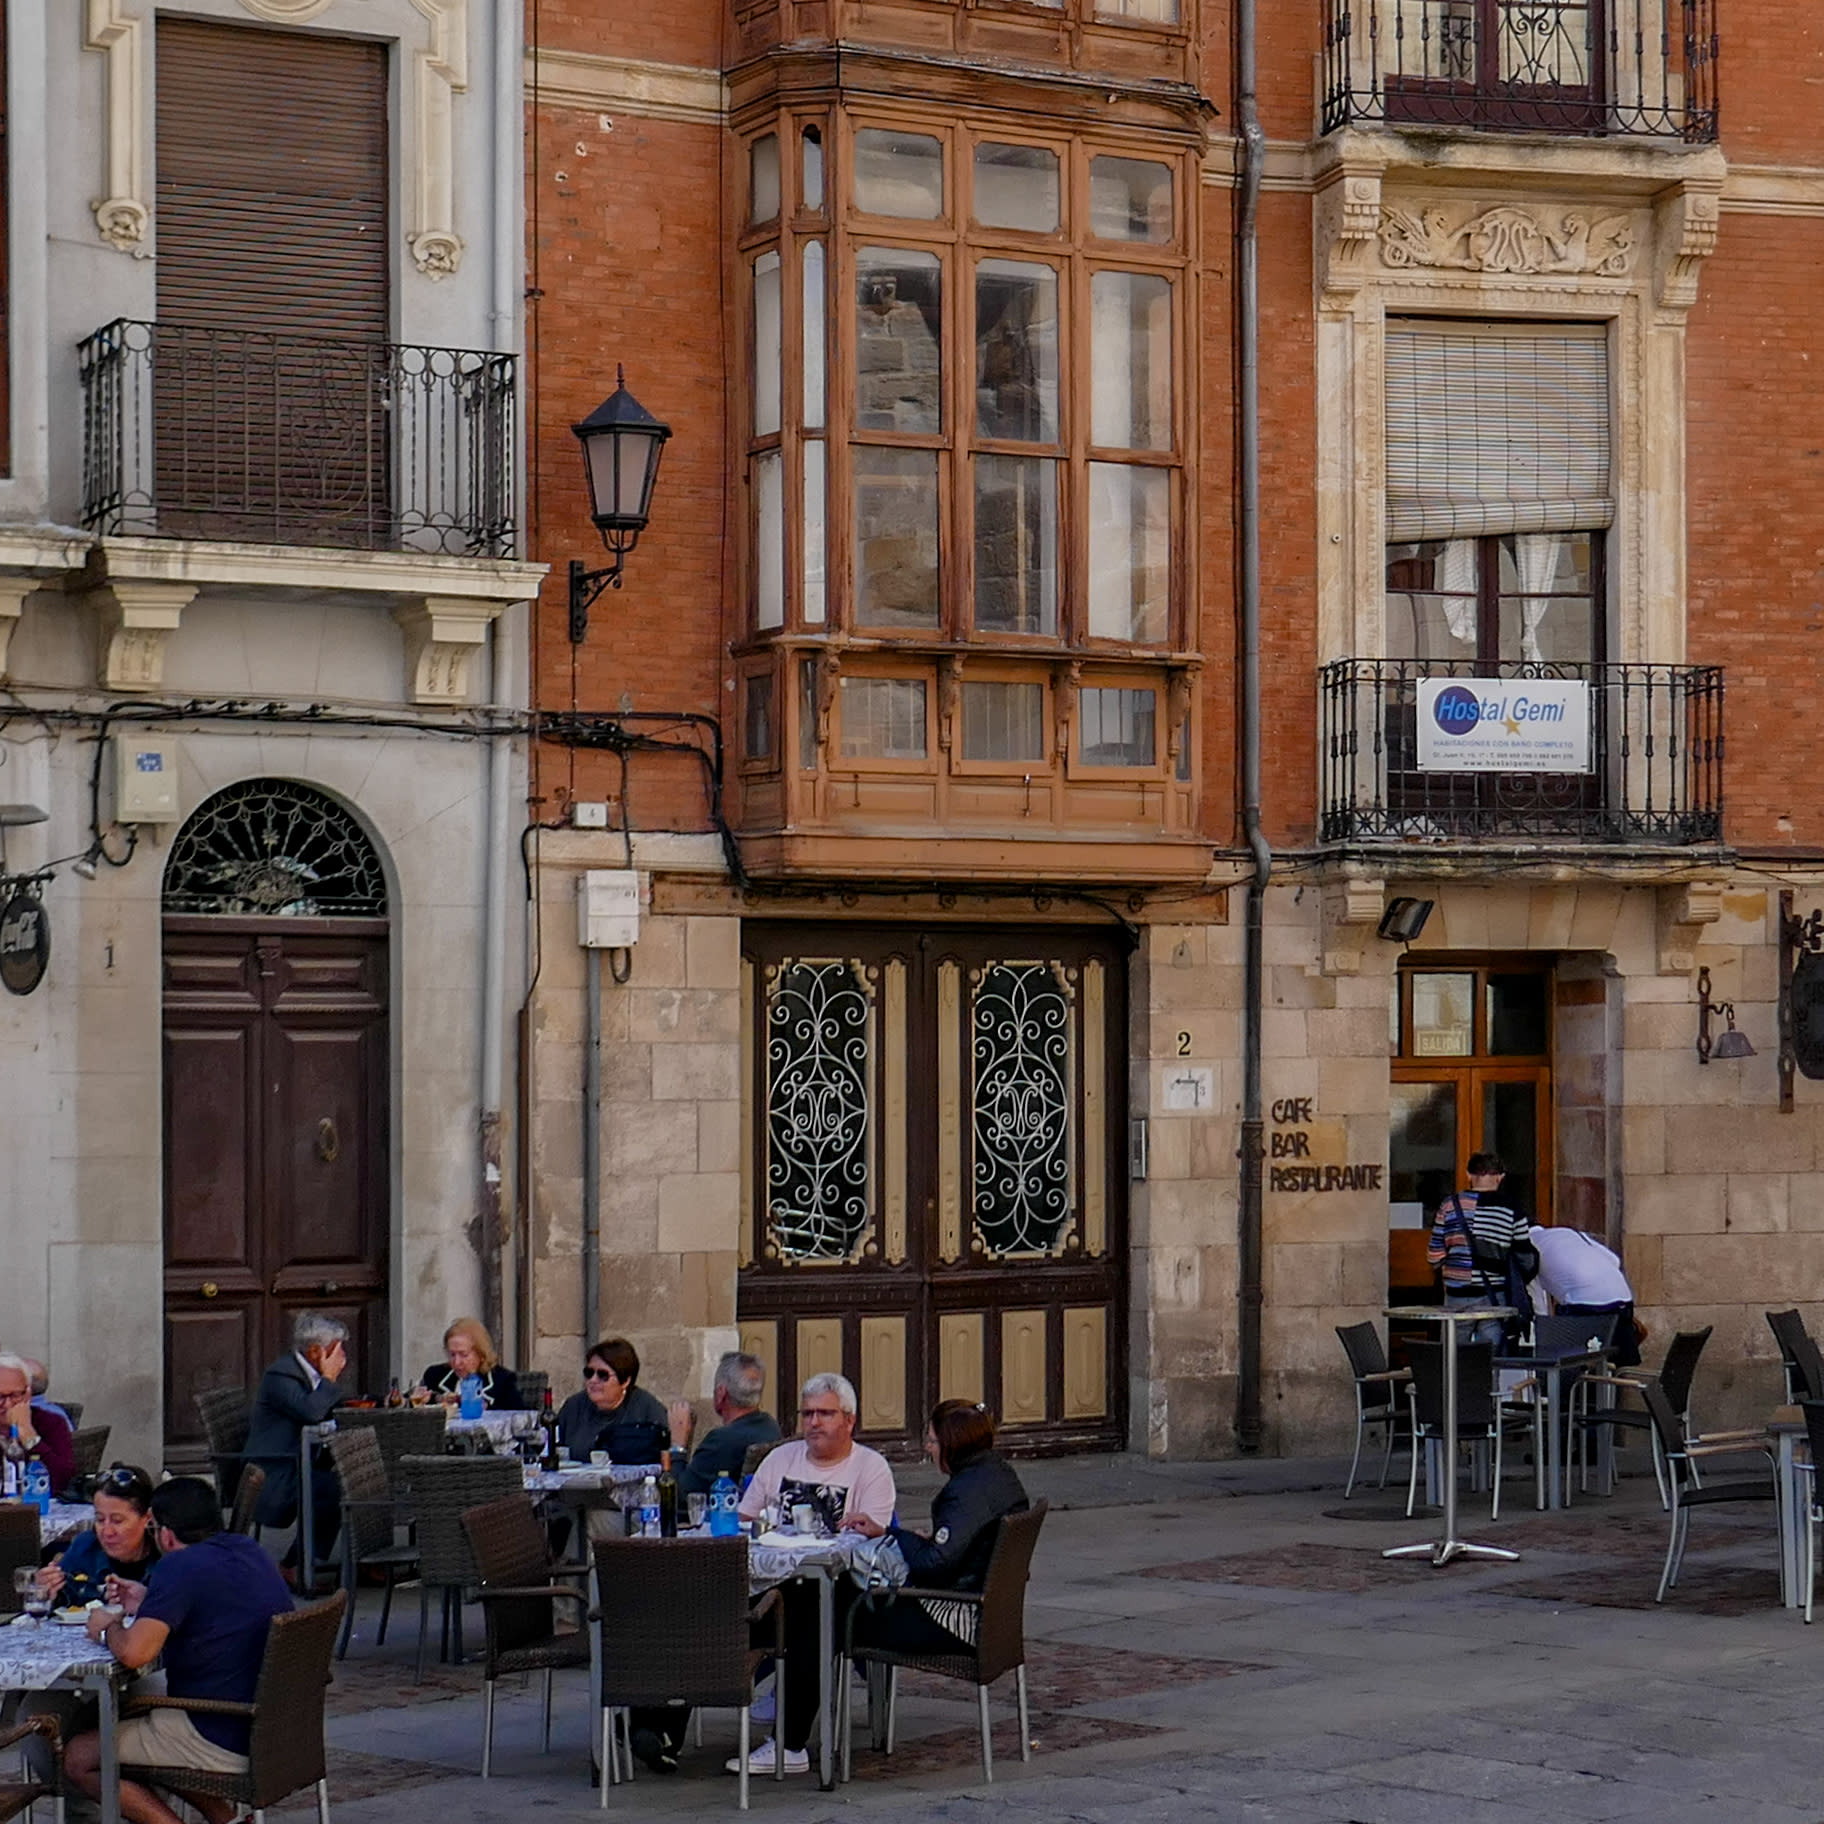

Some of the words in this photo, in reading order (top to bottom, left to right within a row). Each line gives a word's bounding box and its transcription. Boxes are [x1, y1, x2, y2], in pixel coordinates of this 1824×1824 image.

[1437, 695, 1508, 721] Hostal
[1512, 696, 1567, 722] Gemi
[1433, 739, 1491, 748] HABITACIONES
[1492, 739, 1509, 748] CON
[1534, 740, 1574, 749] COMPLETO
[1178, 1031, 1191, 1056] 2
[1271, 1097, 1312, 1124] CAFE
[1271, 1132, 1310, 1159] BAR
